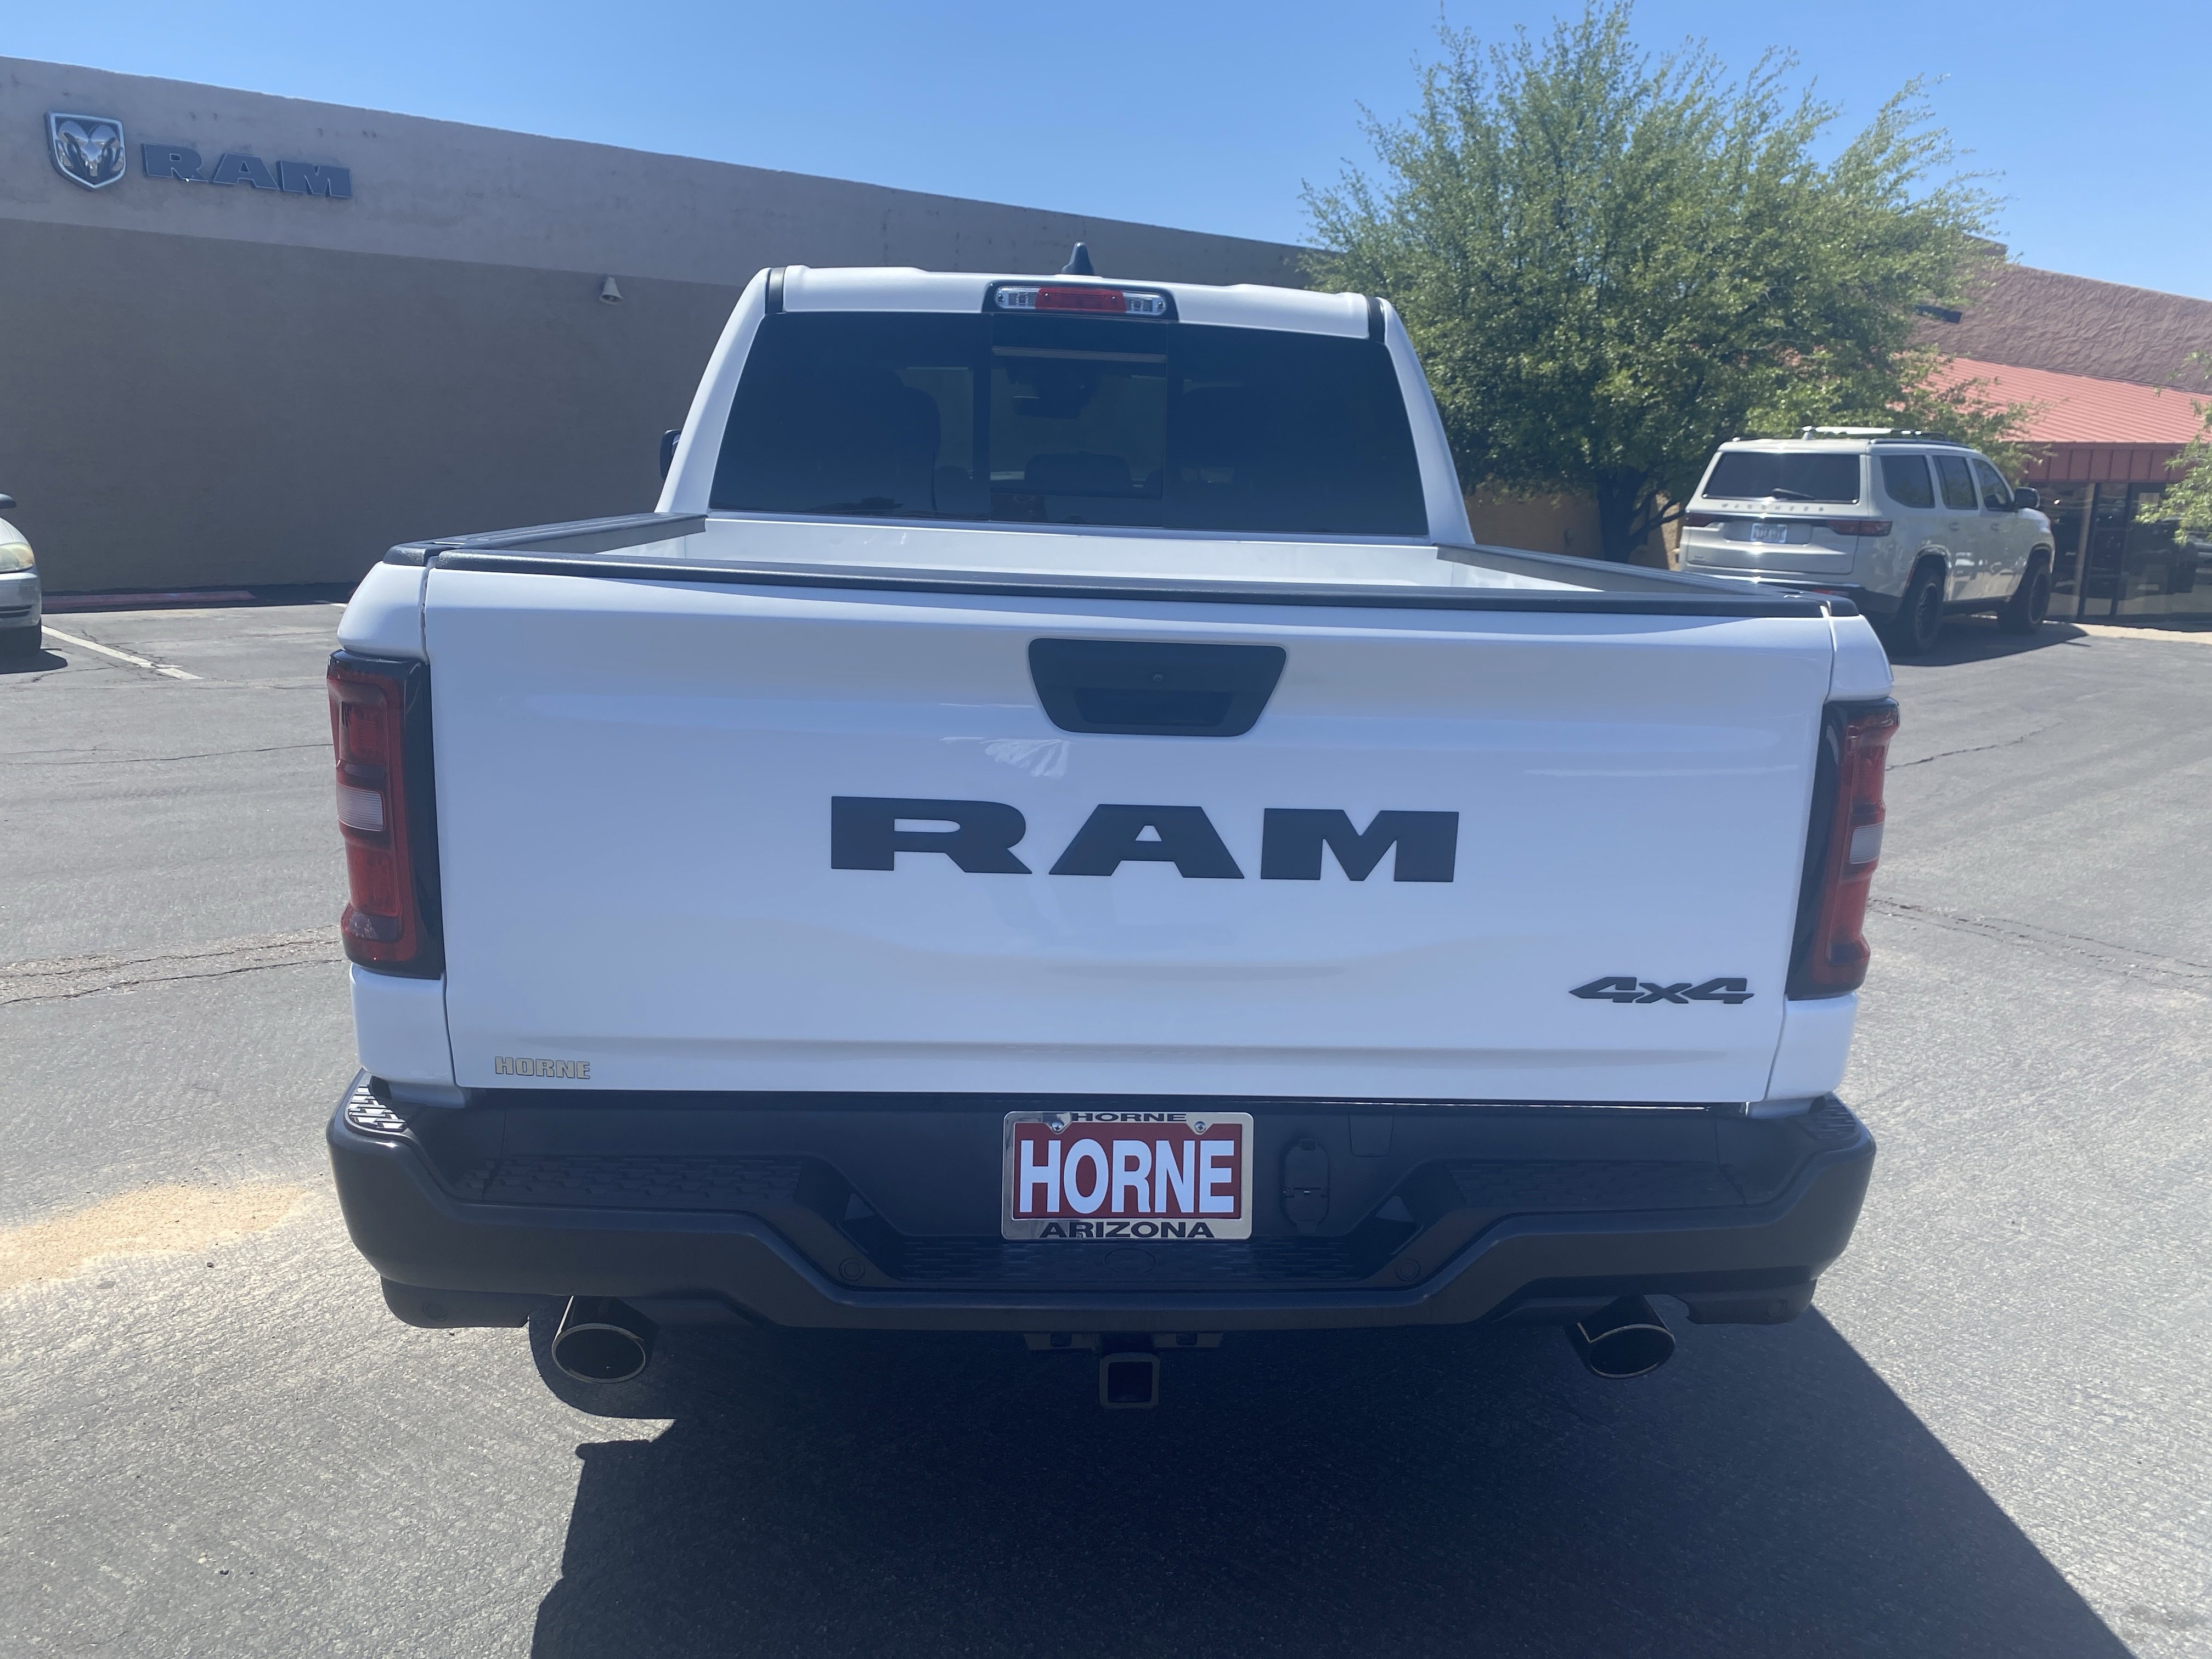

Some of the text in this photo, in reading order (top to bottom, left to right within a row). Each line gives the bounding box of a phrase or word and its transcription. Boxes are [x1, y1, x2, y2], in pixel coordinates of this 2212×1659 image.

[142, 144, 352, 198] RAM
[831, 796, 1459, 882] RAM
[1569, 977, 1754, 1004] 4x4
[495, 1057, 590, 1079] HORNE
[1072, 1113, 1187, 1122] HORNE
[1020, 1138, 1235, 1214] HORNE
[1040, 1222, 1215, 1238] ARIZONA
